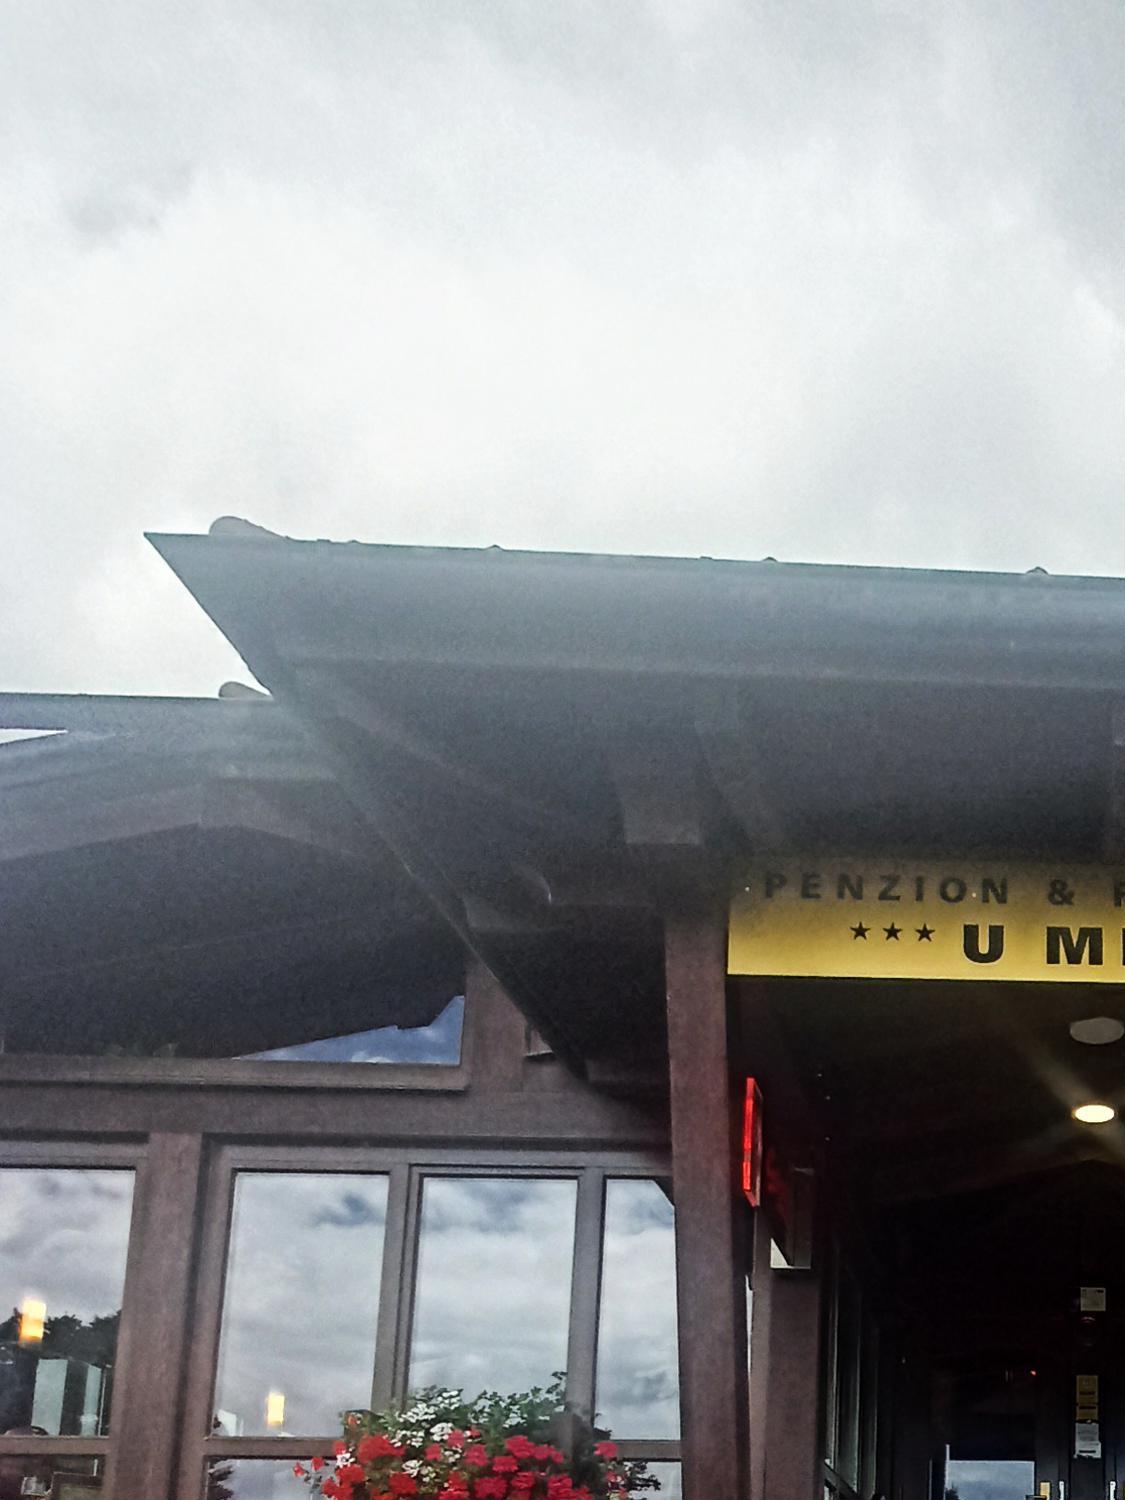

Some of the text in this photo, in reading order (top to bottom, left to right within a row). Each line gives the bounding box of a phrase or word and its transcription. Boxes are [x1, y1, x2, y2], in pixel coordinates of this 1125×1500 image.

[765, 872, 1008, 905] PENZION
[1047, 879, 1075, 906] &
[963, 924, 1004, 963] U
